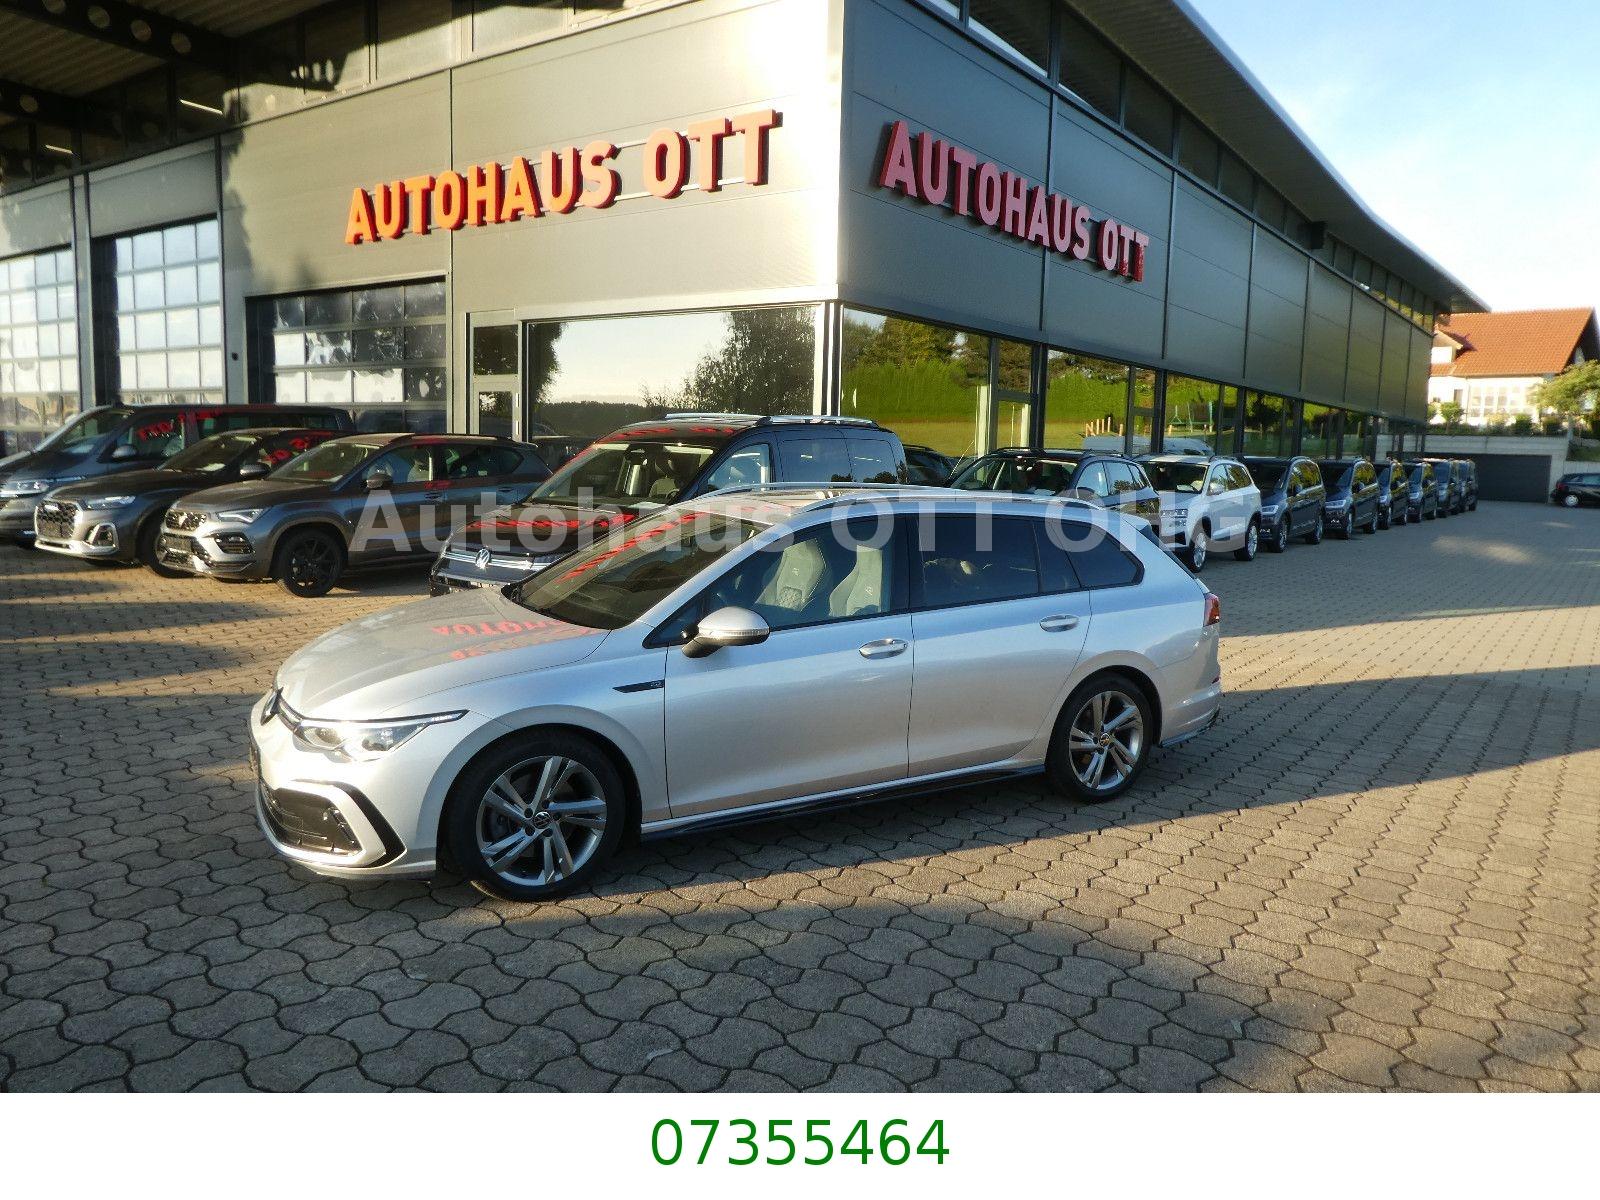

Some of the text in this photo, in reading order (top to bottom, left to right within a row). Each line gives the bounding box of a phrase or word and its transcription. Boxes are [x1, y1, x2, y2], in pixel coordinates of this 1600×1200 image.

[344, 108, 783, 245] AUTOHAUS OTT
[879, 119, 1150, 282] AUTOHAUS OTT
